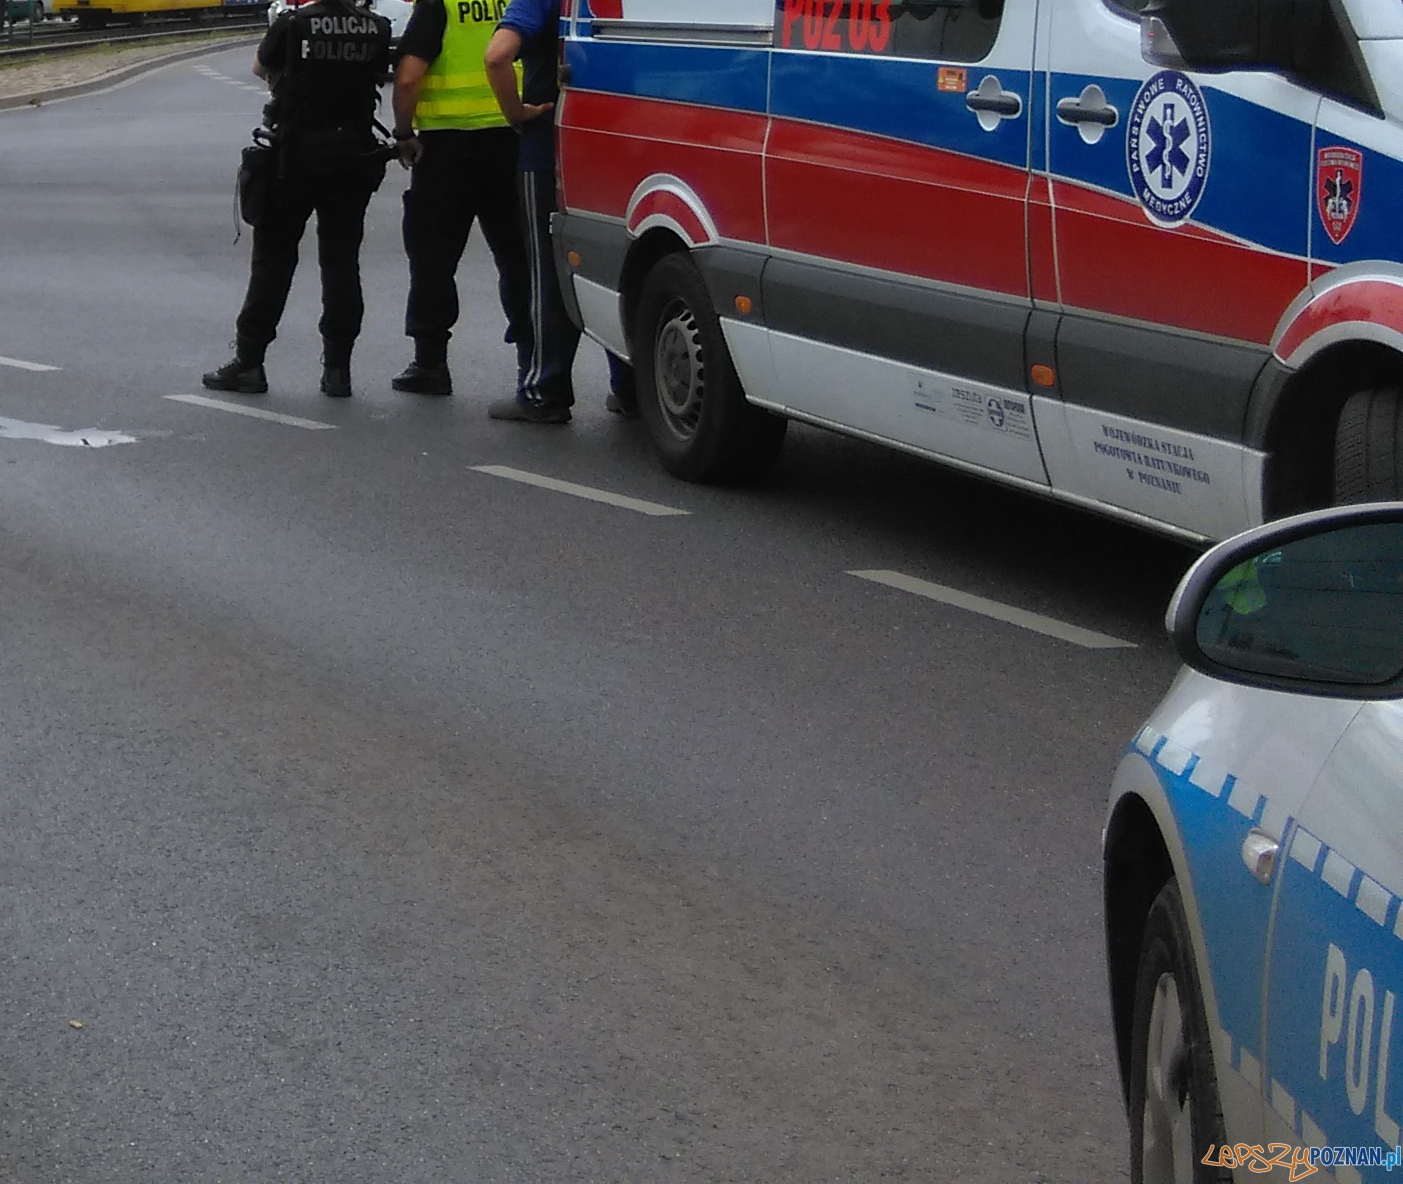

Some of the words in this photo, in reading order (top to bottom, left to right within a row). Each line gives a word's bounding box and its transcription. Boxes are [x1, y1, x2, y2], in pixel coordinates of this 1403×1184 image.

[311, 17, 378, 35] POLICJA
[1175, 78, 1207, 178] RATOWNICTWO
[1143, 187, 1192, 215] MEDYCZNE
[1161, 440, 1194, 461] STACJA
